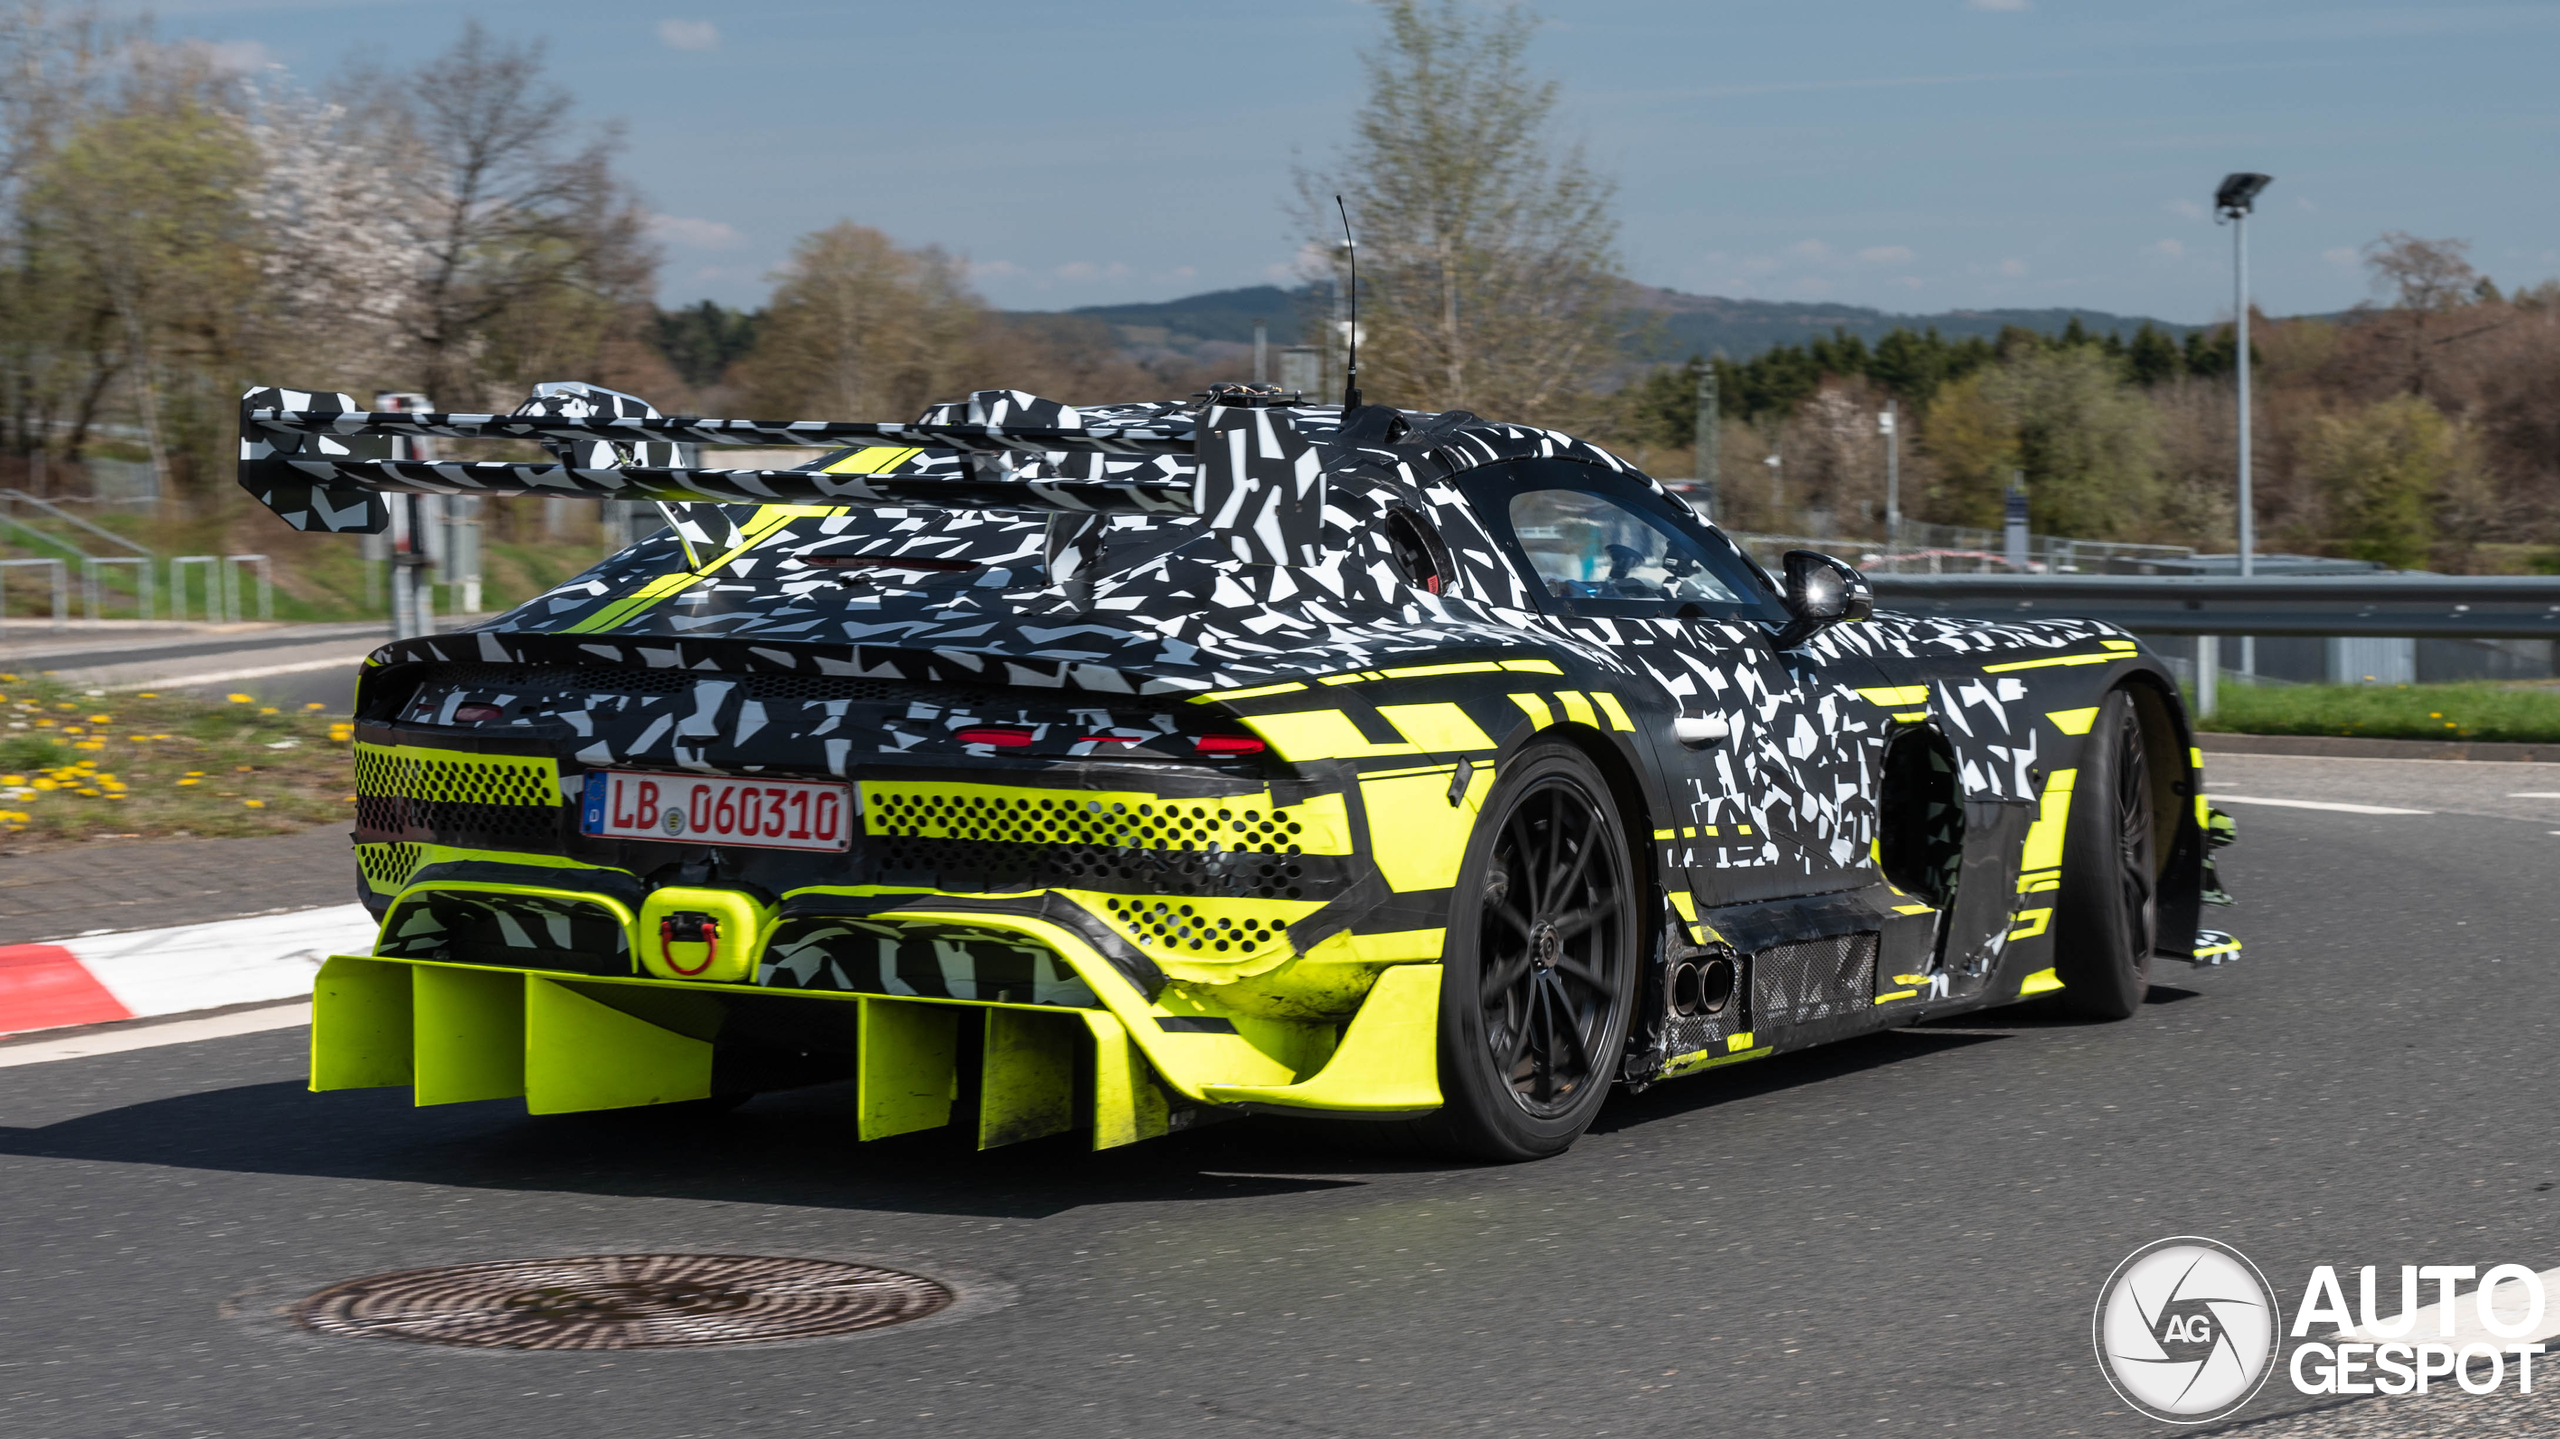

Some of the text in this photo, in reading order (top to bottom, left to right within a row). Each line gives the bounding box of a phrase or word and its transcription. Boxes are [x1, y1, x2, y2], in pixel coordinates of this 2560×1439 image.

[589, 808, 600, 822] D
[613, 780, 839, 841] LB 060310
